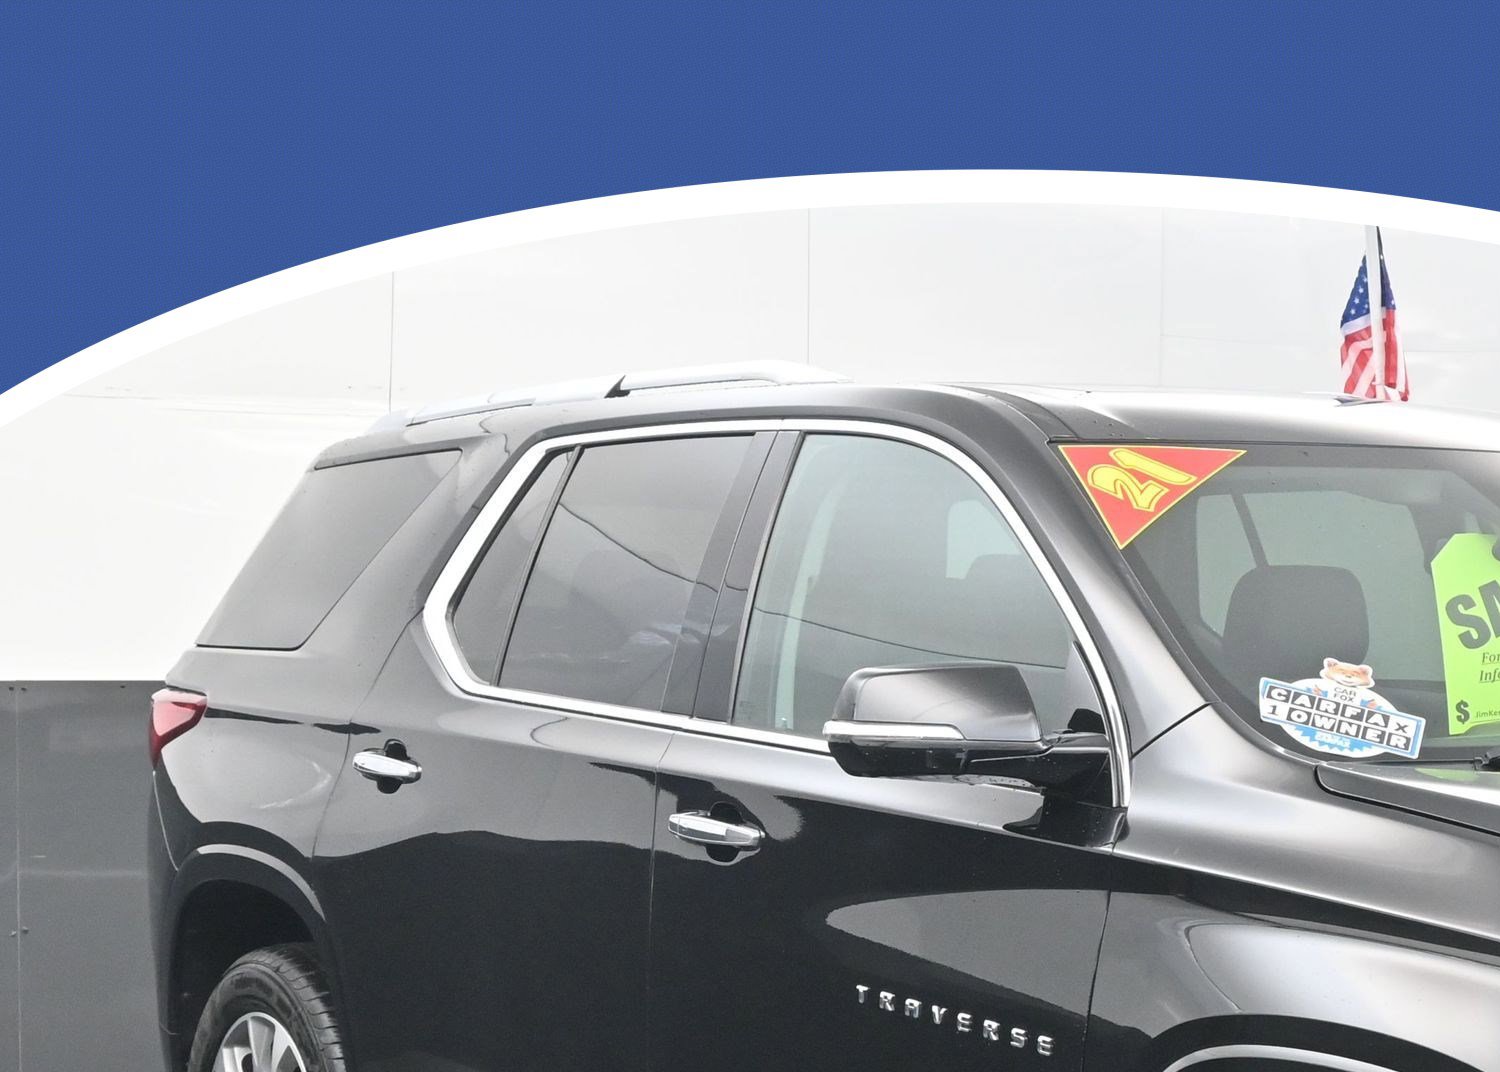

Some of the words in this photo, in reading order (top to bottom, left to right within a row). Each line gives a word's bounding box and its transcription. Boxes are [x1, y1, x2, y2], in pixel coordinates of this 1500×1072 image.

[1087, 448, 1198, 512] 21
[1270, 689, 1409, 734] CARFAX
[1333, 693, 1354, 703] FOX
[1334, 686, 1357, 698] CAR
[1267, 705, 1279, 716] 1
[1290, 710, 1407, 749] OWNER
[856, 984, 1055, 1057] TRAVERSE
